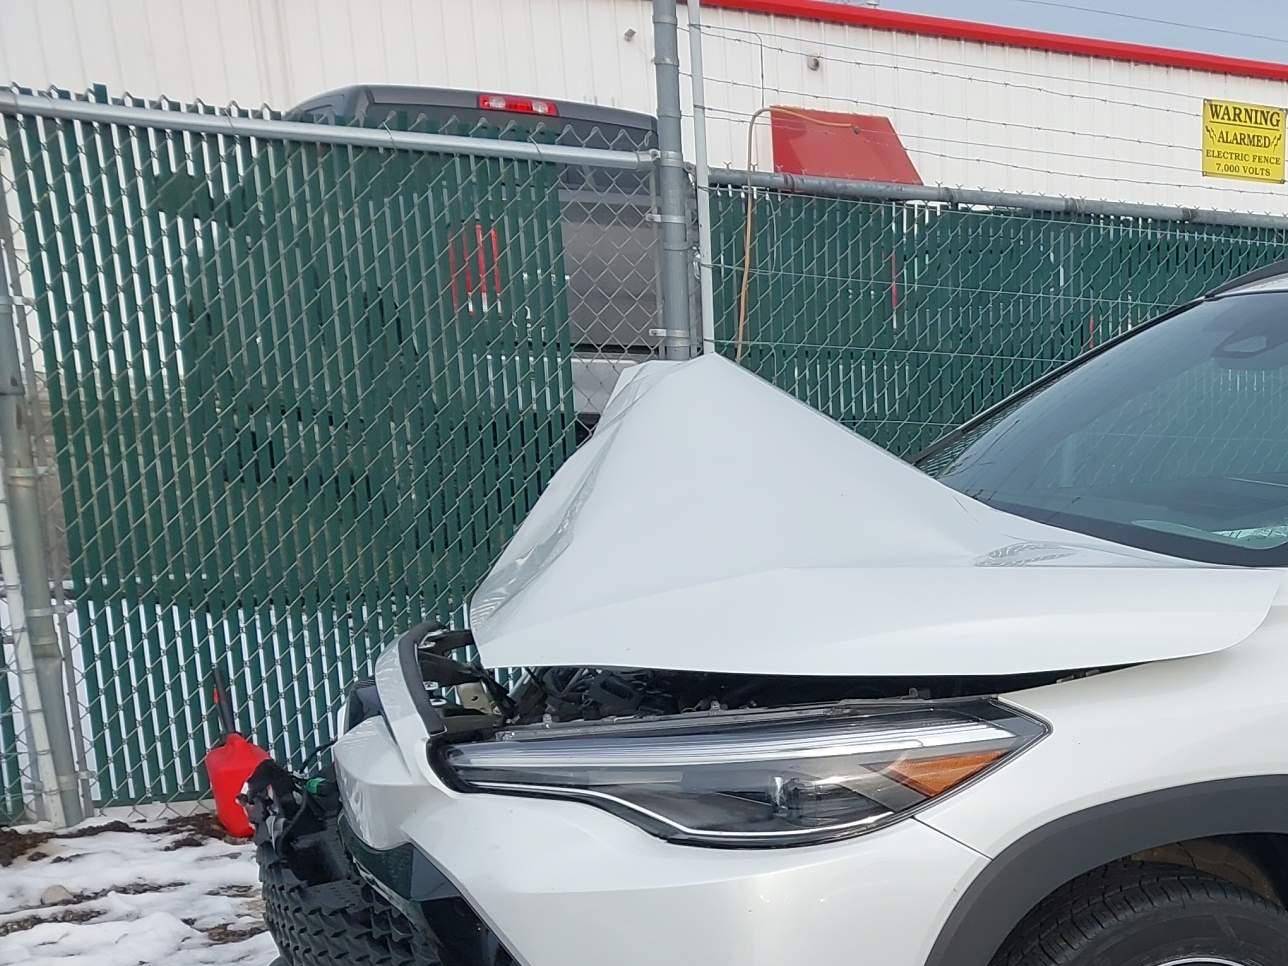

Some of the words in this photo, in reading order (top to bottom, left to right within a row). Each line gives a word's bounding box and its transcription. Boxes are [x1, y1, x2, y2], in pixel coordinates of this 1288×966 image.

[1209, 103, 1280, 127] WARNING
[1217, 130, 1270, 148] ALARMED
[1206, 149, 1249, 162] ELECTRIC
[1252, 154, 1281, 165] FENCE
[1216, 163, 1240, 173] 7,000
[1242, 166, 1271, 176] VOLTS
